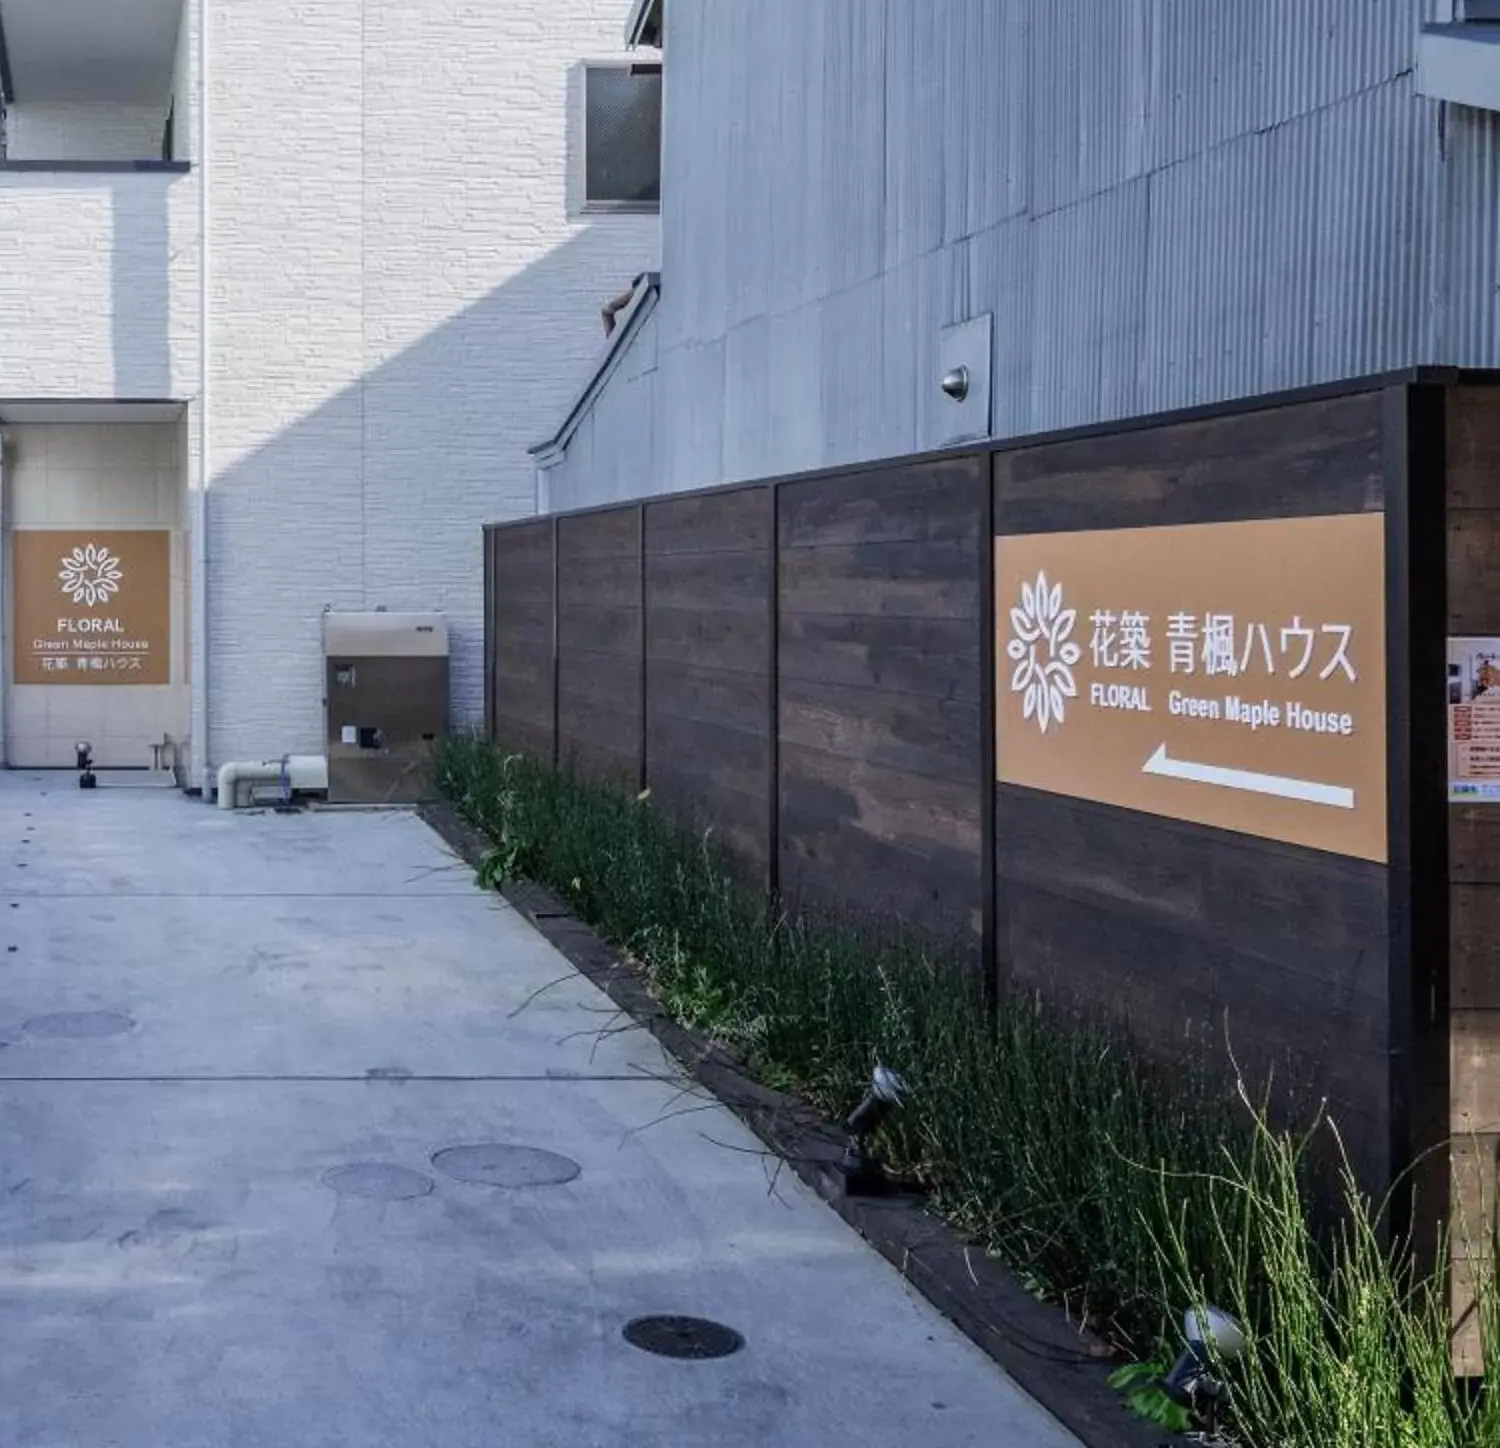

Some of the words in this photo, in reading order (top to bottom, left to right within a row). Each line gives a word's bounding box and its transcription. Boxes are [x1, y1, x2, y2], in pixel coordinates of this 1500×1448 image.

[56, 617, 125, 633] FLORAL
[32, 638, 69, 650] Green
[72, 638, 108, 651] Maple
[110, 638, 150, 650] House
[1088, 608, 1152, 670] 花築
[1165, 611, 1358, 683] 青楓ハウス
[1090, 682, 1152, 712] FLORAL
[1167, 689, 1220, 720] Green
[1224, 695, 1281, 731] Maple
[1285, 701, 1354, 735] House
